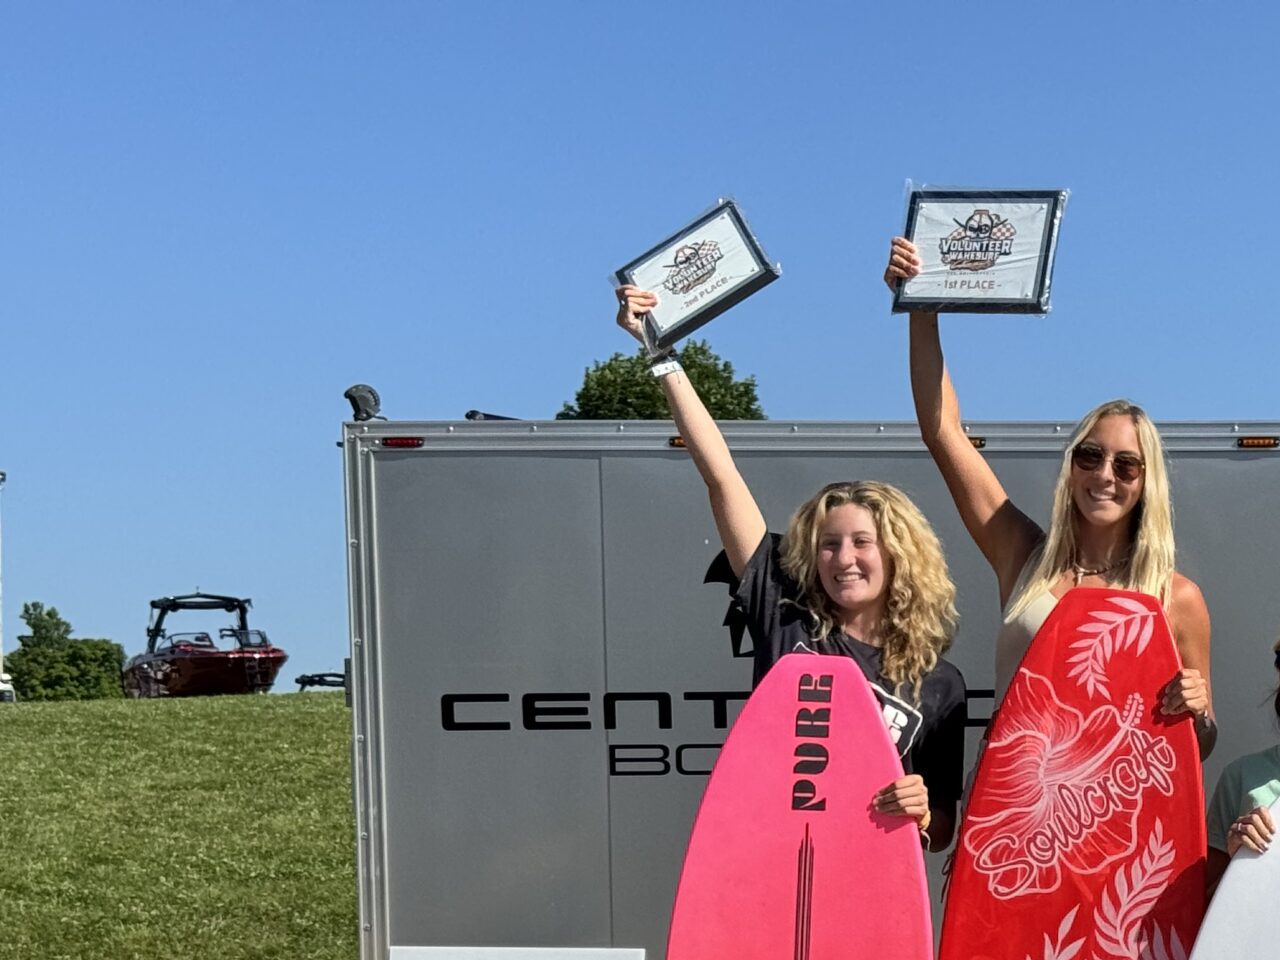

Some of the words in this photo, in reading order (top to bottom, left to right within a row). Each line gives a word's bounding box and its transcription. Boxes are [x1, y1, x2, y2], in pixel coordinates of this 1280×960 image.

[941, 239, 1012, 254] VOLUNTEER
[664, 250, 723, 290] VOLUNTEER
[944, 280, 957, 289] 1st
[959, 280, 995, 289] PLACE
[700, 277, 729, 298] PLACE
[792, 673, 834, 811] PURE
[975, 727, 1177, 900] Soulcraft
